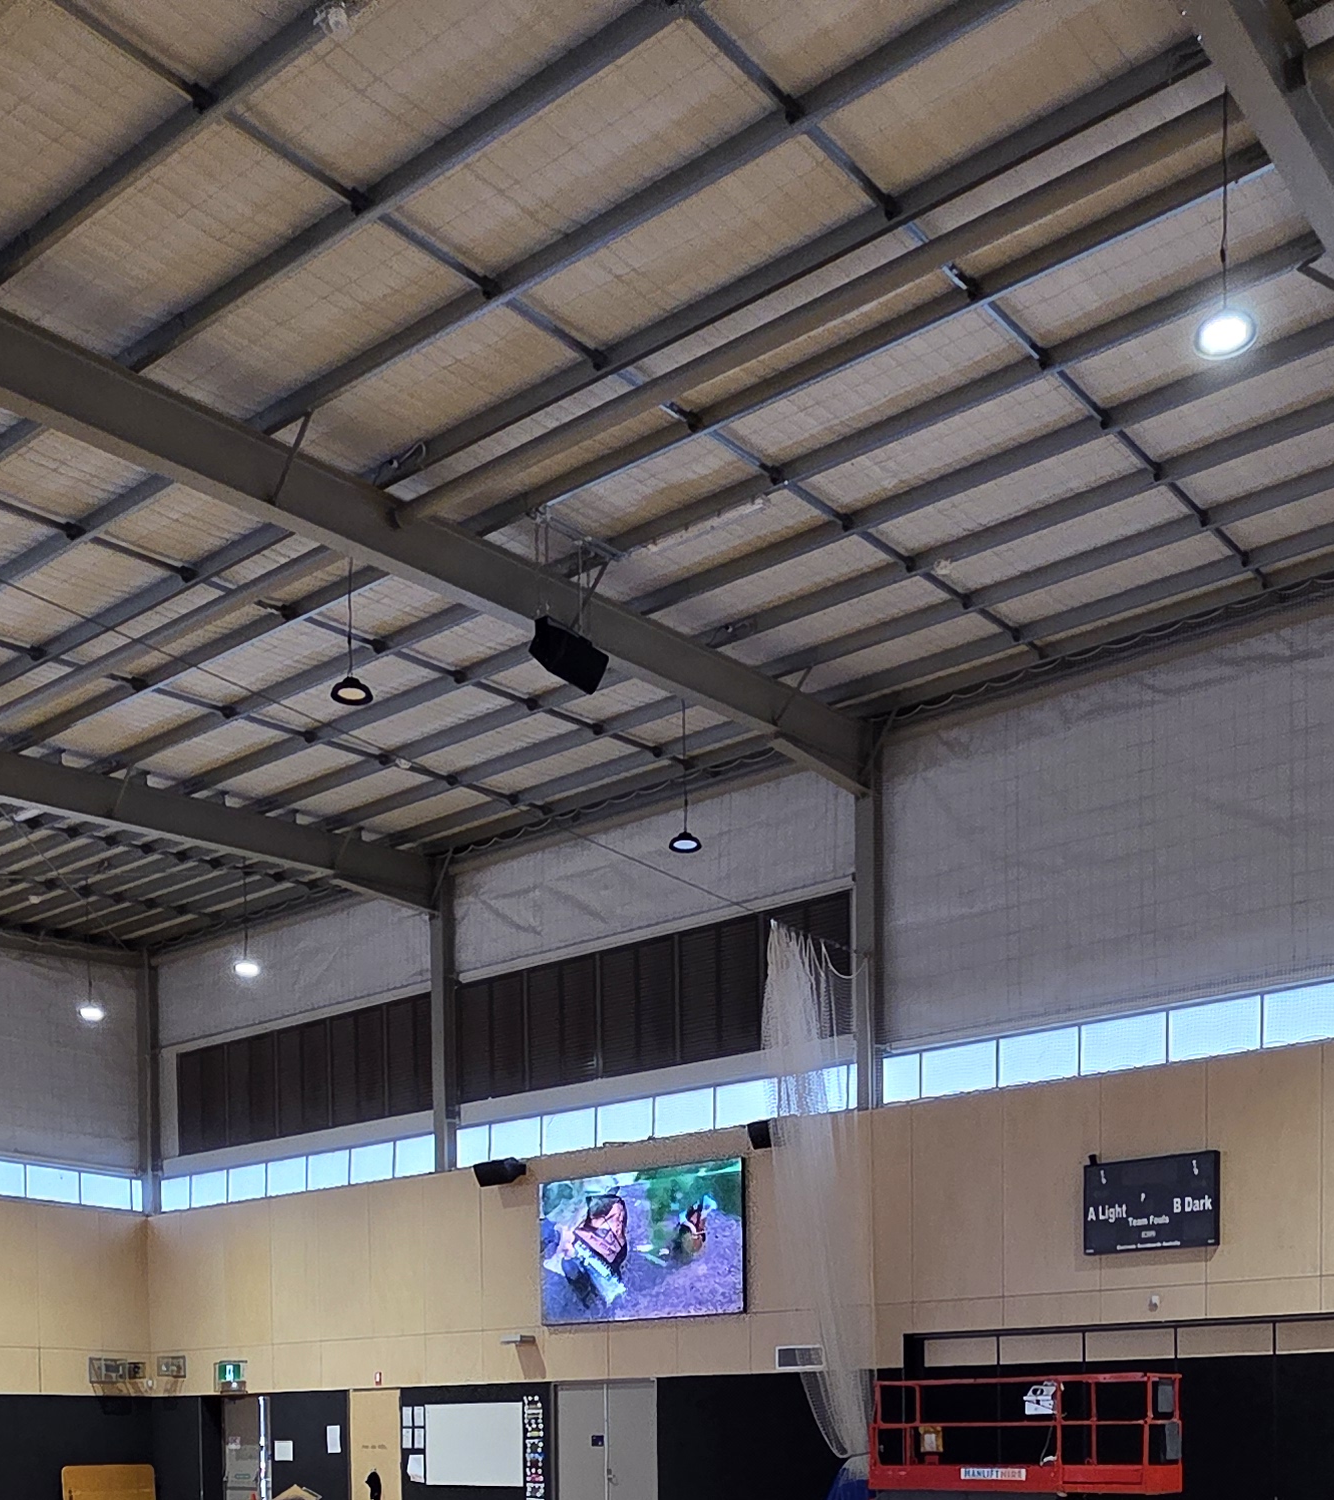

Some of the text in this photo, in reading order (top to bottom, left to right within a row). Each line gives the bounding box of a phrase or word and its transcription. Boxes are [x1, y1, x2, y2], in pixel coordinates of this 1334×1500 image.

[1087, 1203, 1127, 1223] A Light
[1173, 1194, 1213, 1213] B Dark
[1128, 1214, 1170, 1227] Team Fouls
